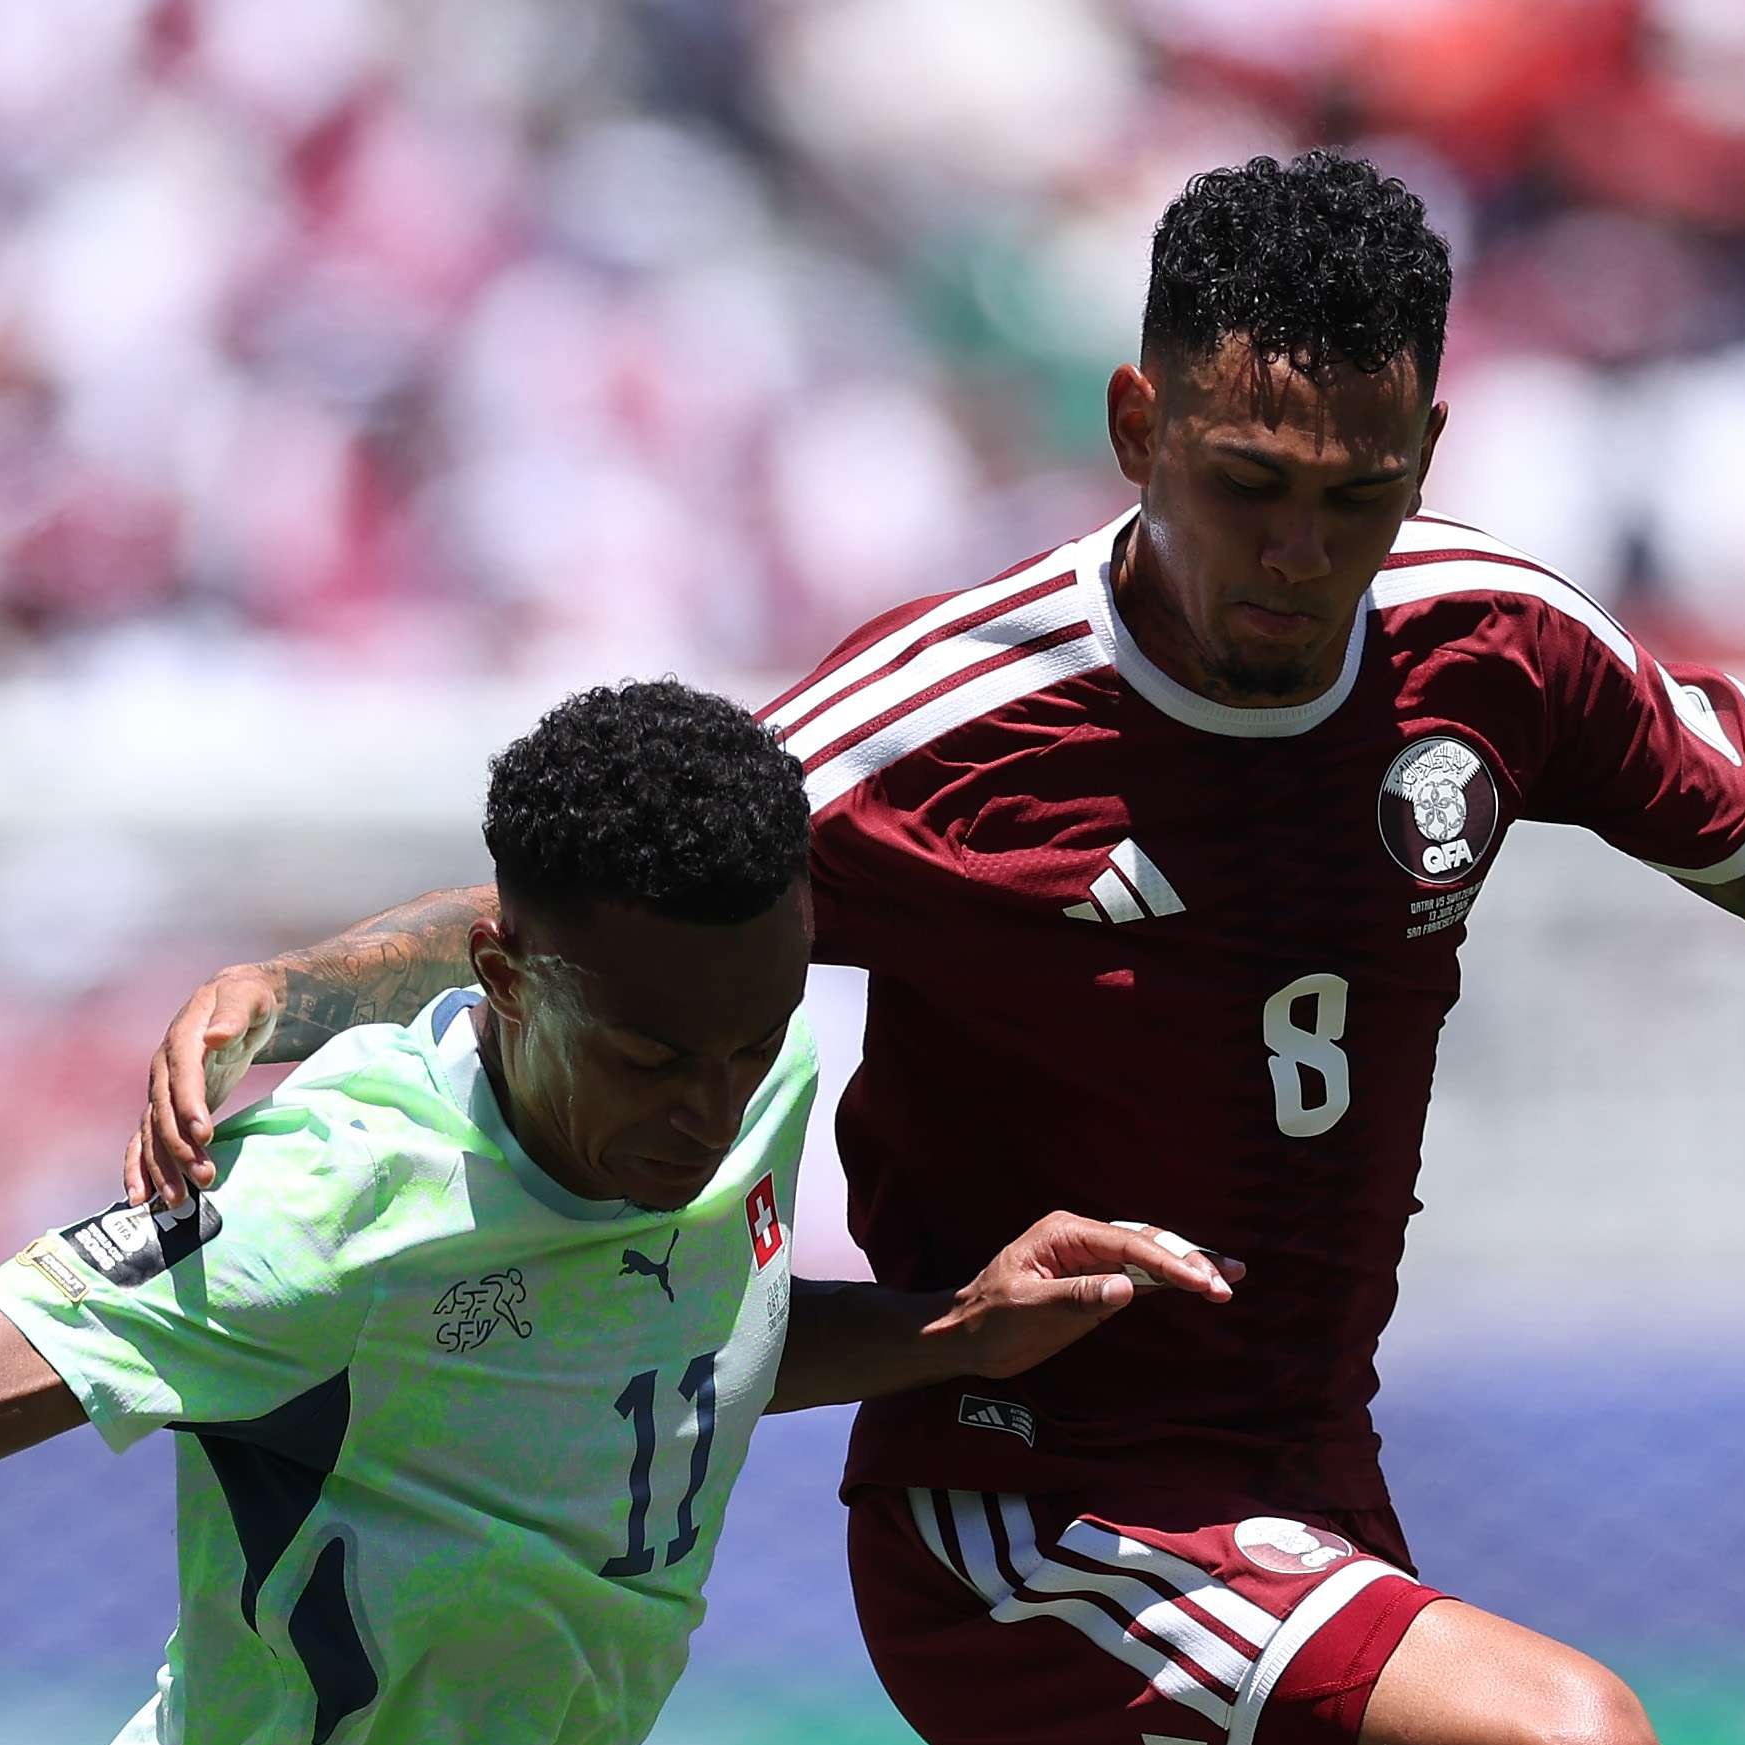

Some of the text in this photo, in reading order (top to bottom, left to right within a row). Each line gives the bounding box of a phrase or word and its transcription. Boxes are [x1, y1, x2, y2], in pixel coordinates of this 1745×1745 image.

[1422, 838, 1473, 874] QFA
[1263, 972, 1351, 1138] 8
[114, 1221, 132, 1241] FIFA
[598, 1350, 717, 1578] 11
